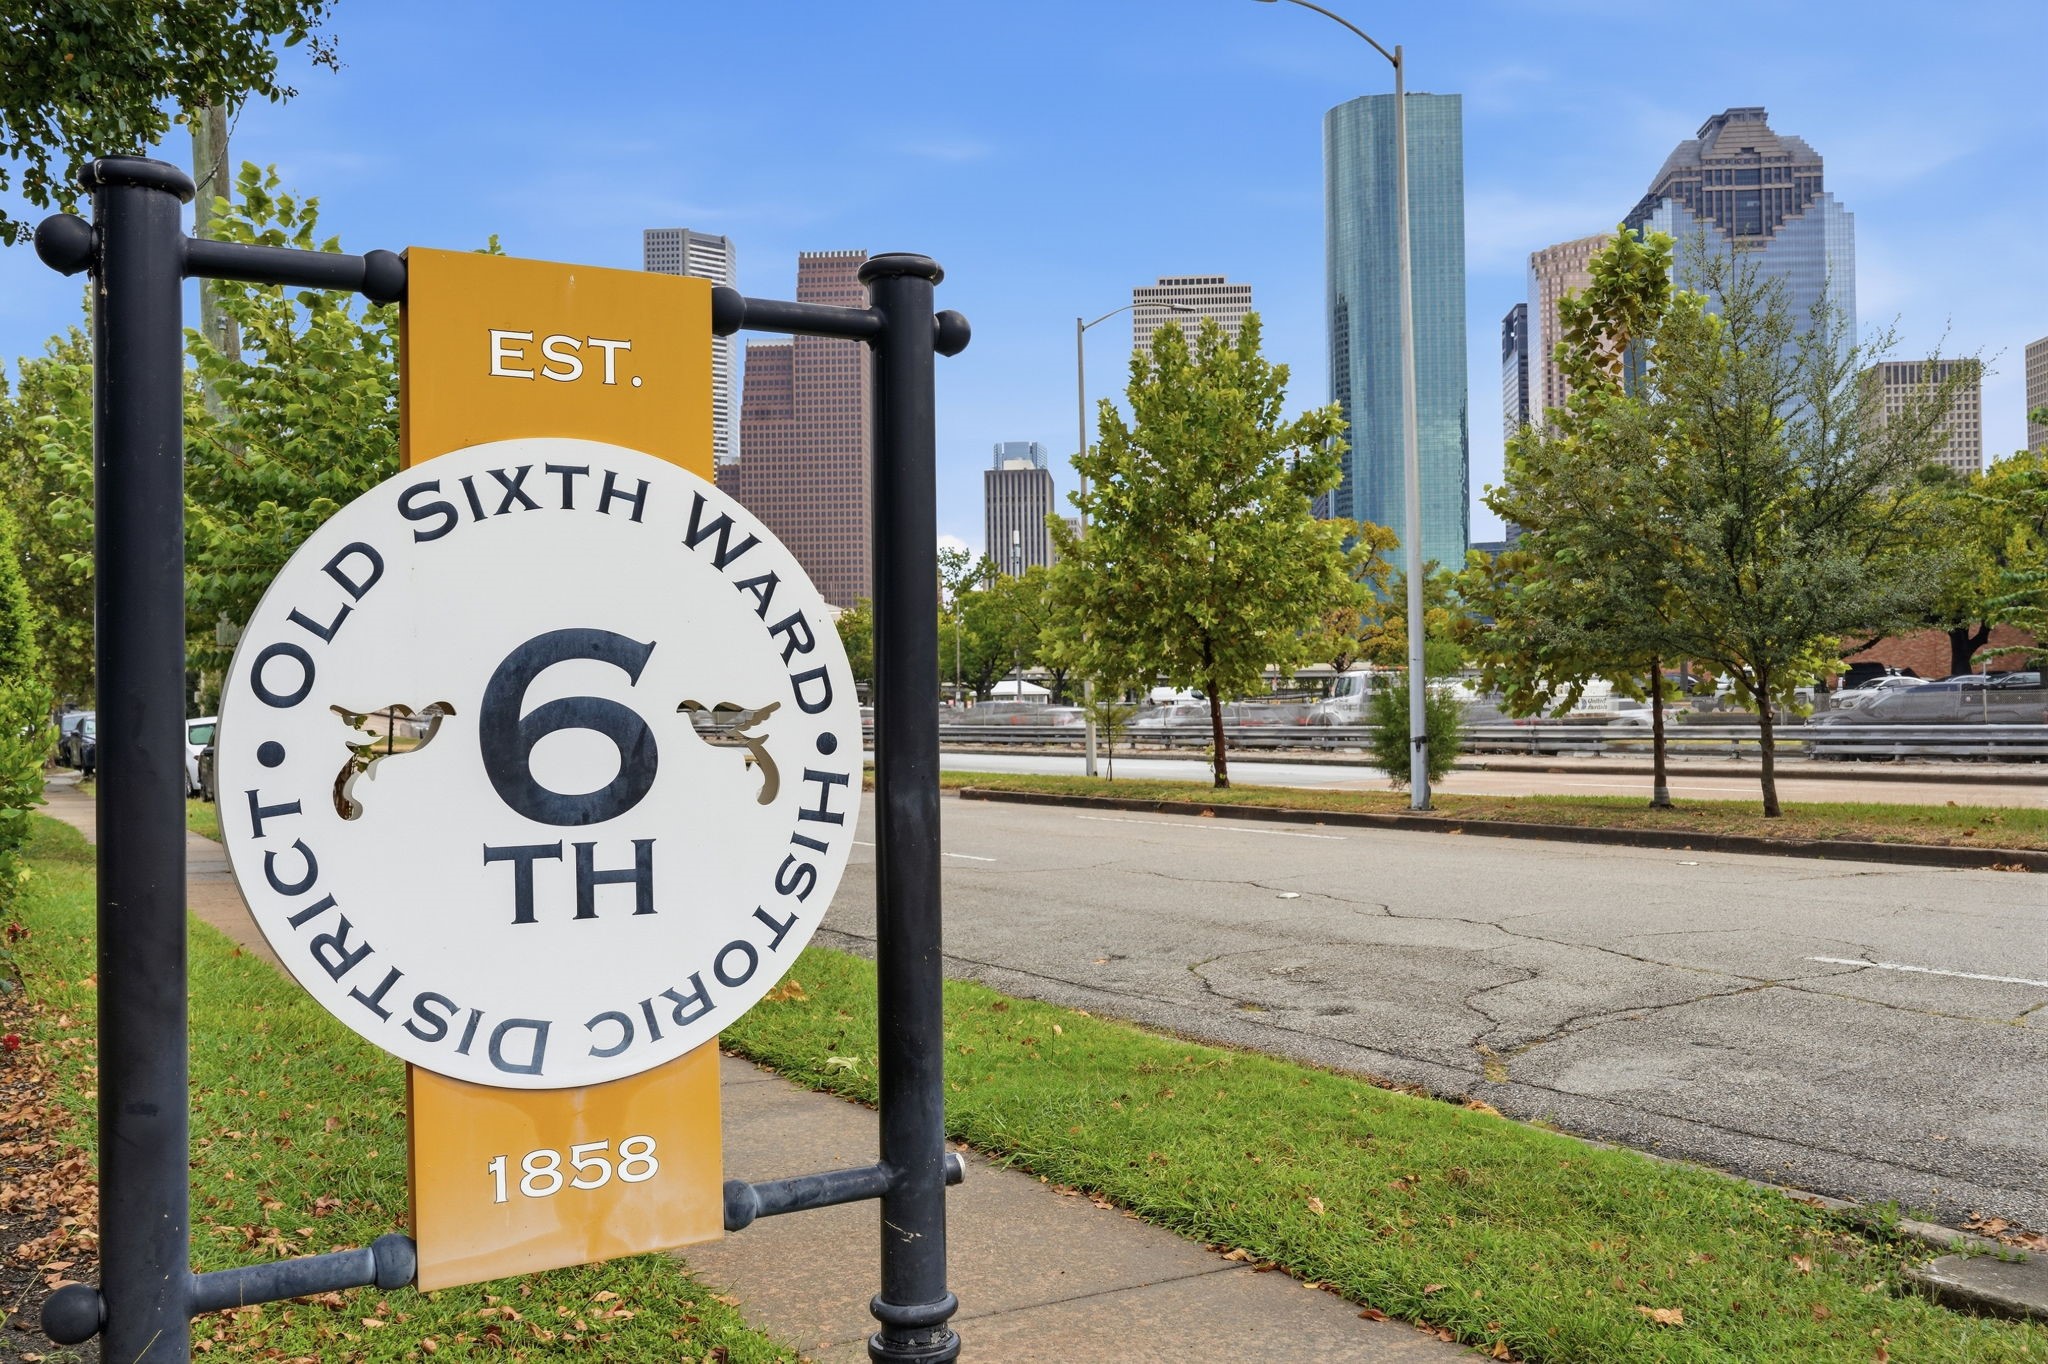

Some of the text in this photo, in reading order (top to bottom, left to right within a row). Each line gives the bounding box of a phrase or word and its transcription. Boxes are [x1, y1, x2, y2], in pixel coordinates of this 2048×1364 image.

[488, 328, 643, 388] EST.
[250, 462, 833, 715] OLD SIXTH WARD
[479, 627, 659, 827] 6
[244, 766, 850, 1076] HISTORIC DISTRICT
[483, 838, 658, 925] TH
[488, 1134, 660, 1204] 1858
